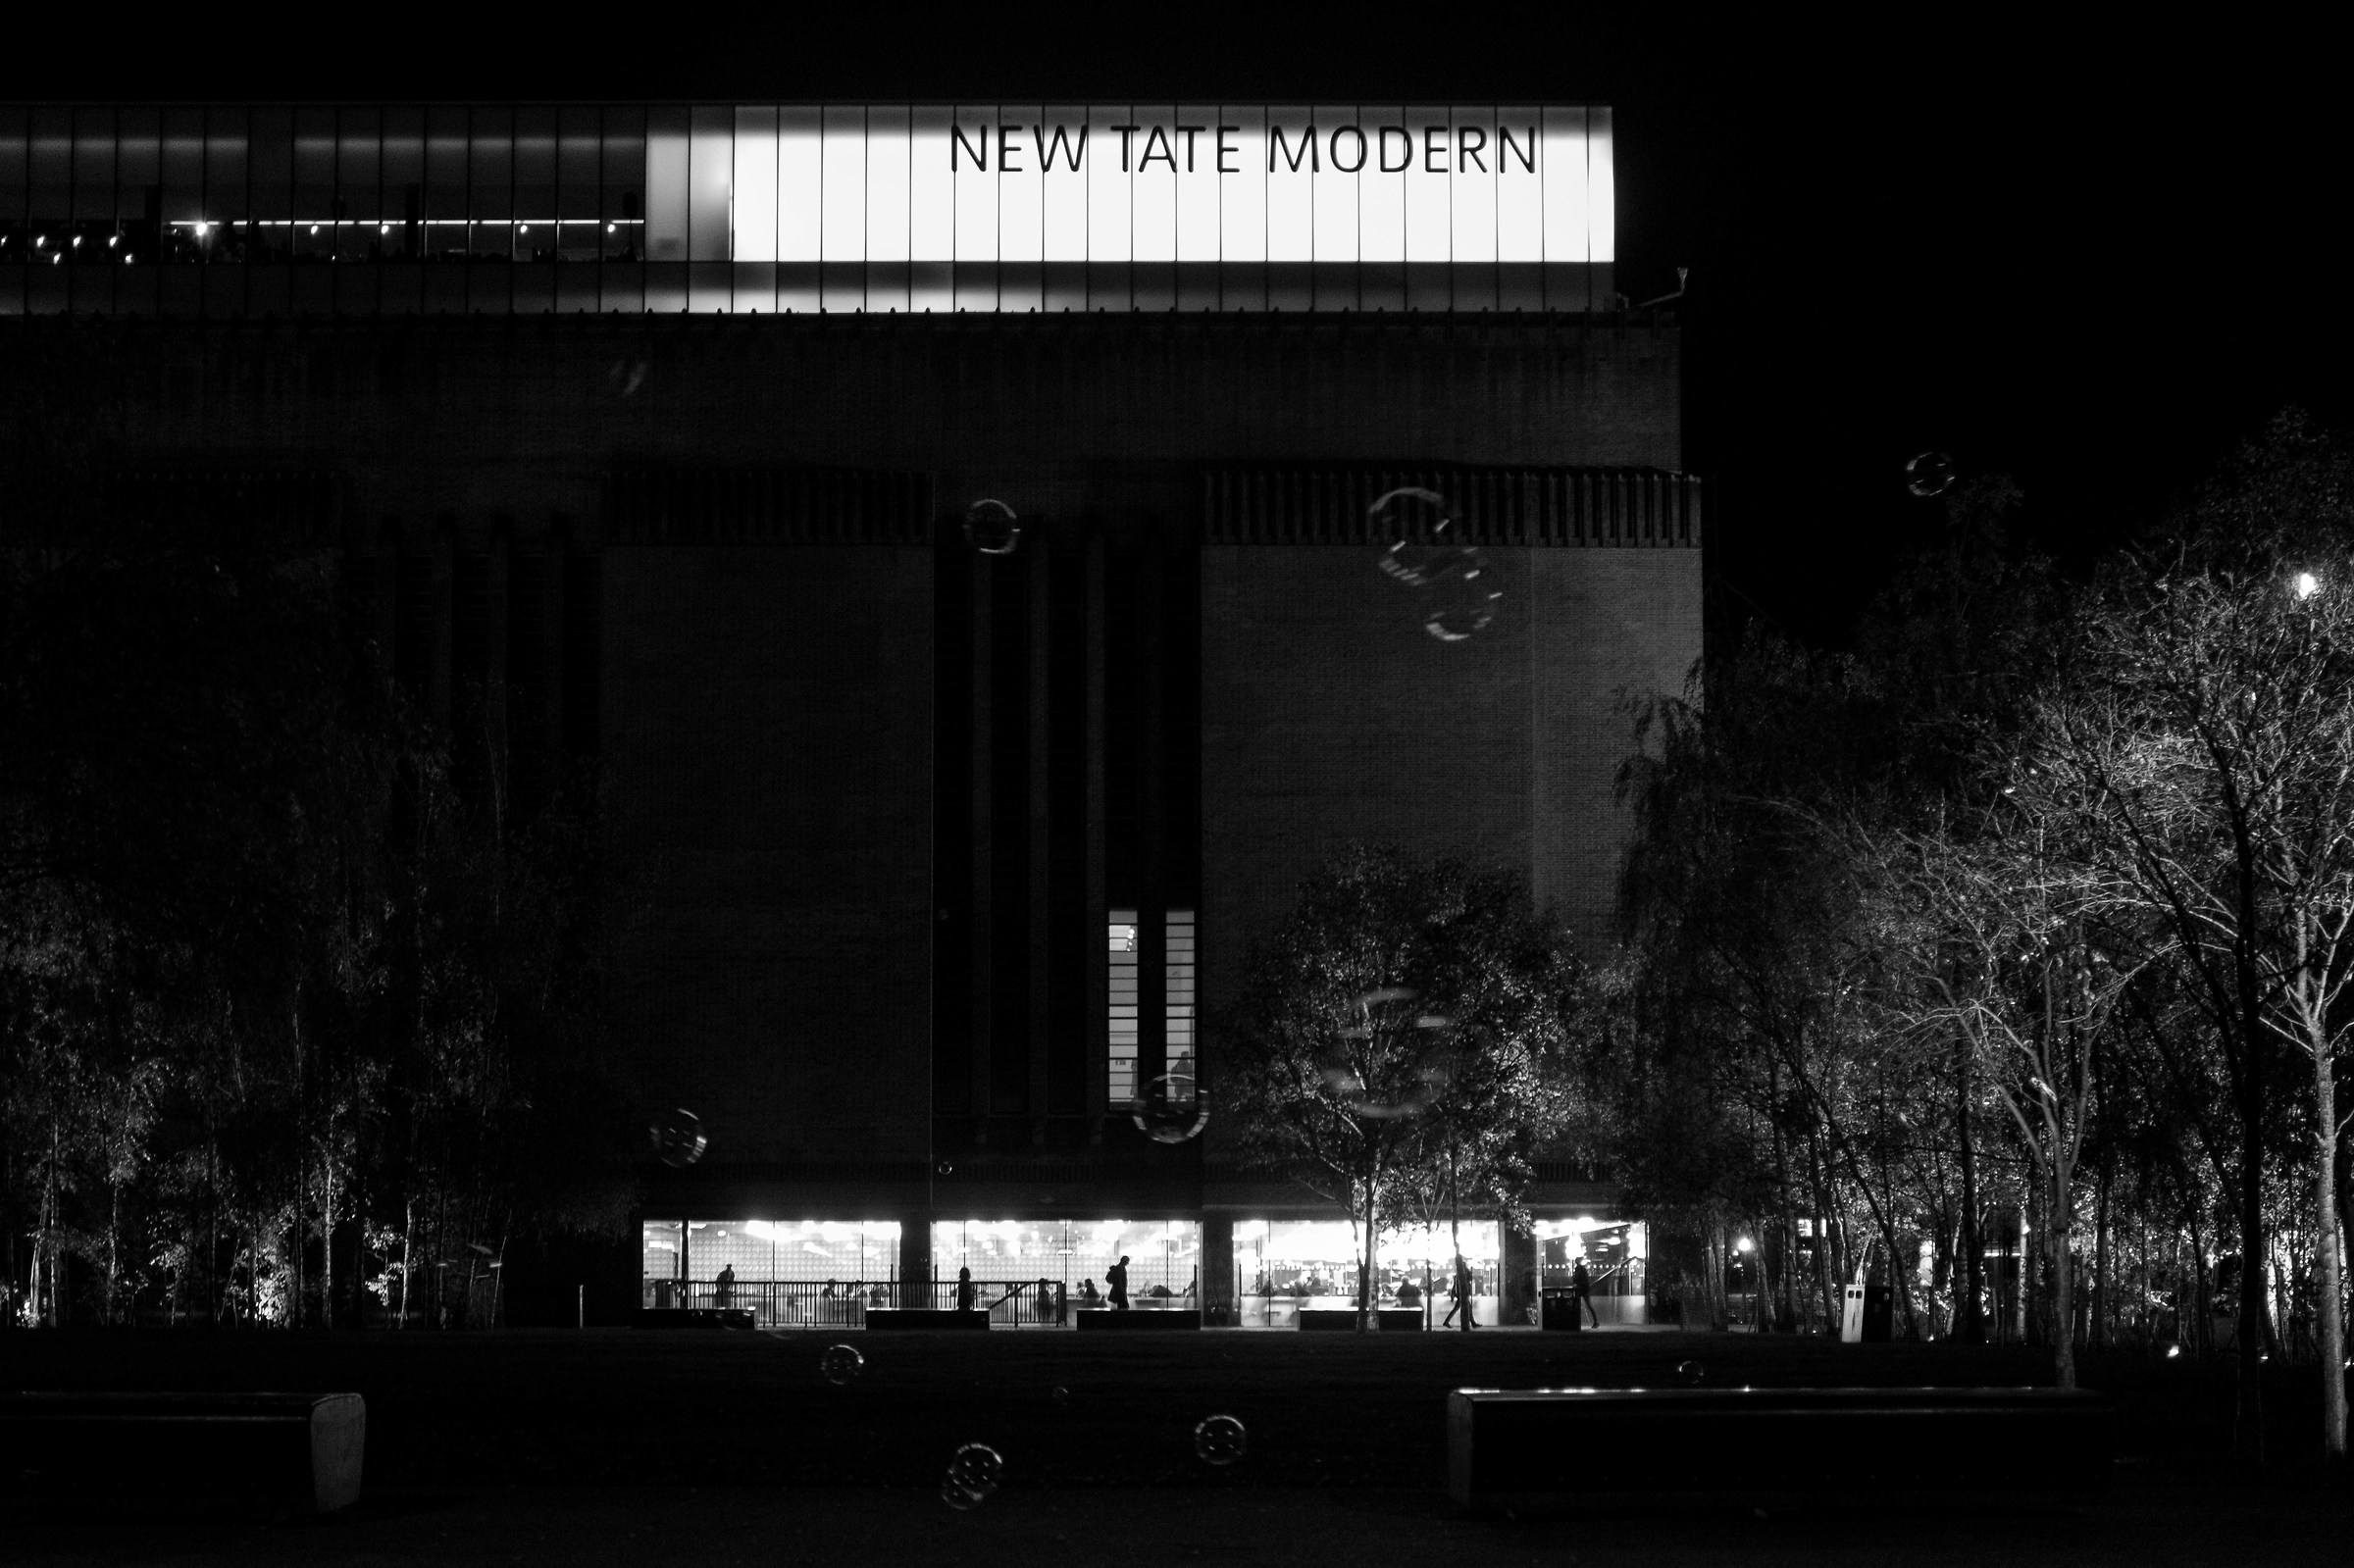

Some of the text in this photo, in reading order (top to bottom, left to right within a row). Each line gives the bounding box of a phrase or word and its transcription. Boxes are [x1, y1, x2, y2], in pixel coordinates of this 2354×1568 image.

[951, 125, 1536, 174] NEW TATE MODERN
